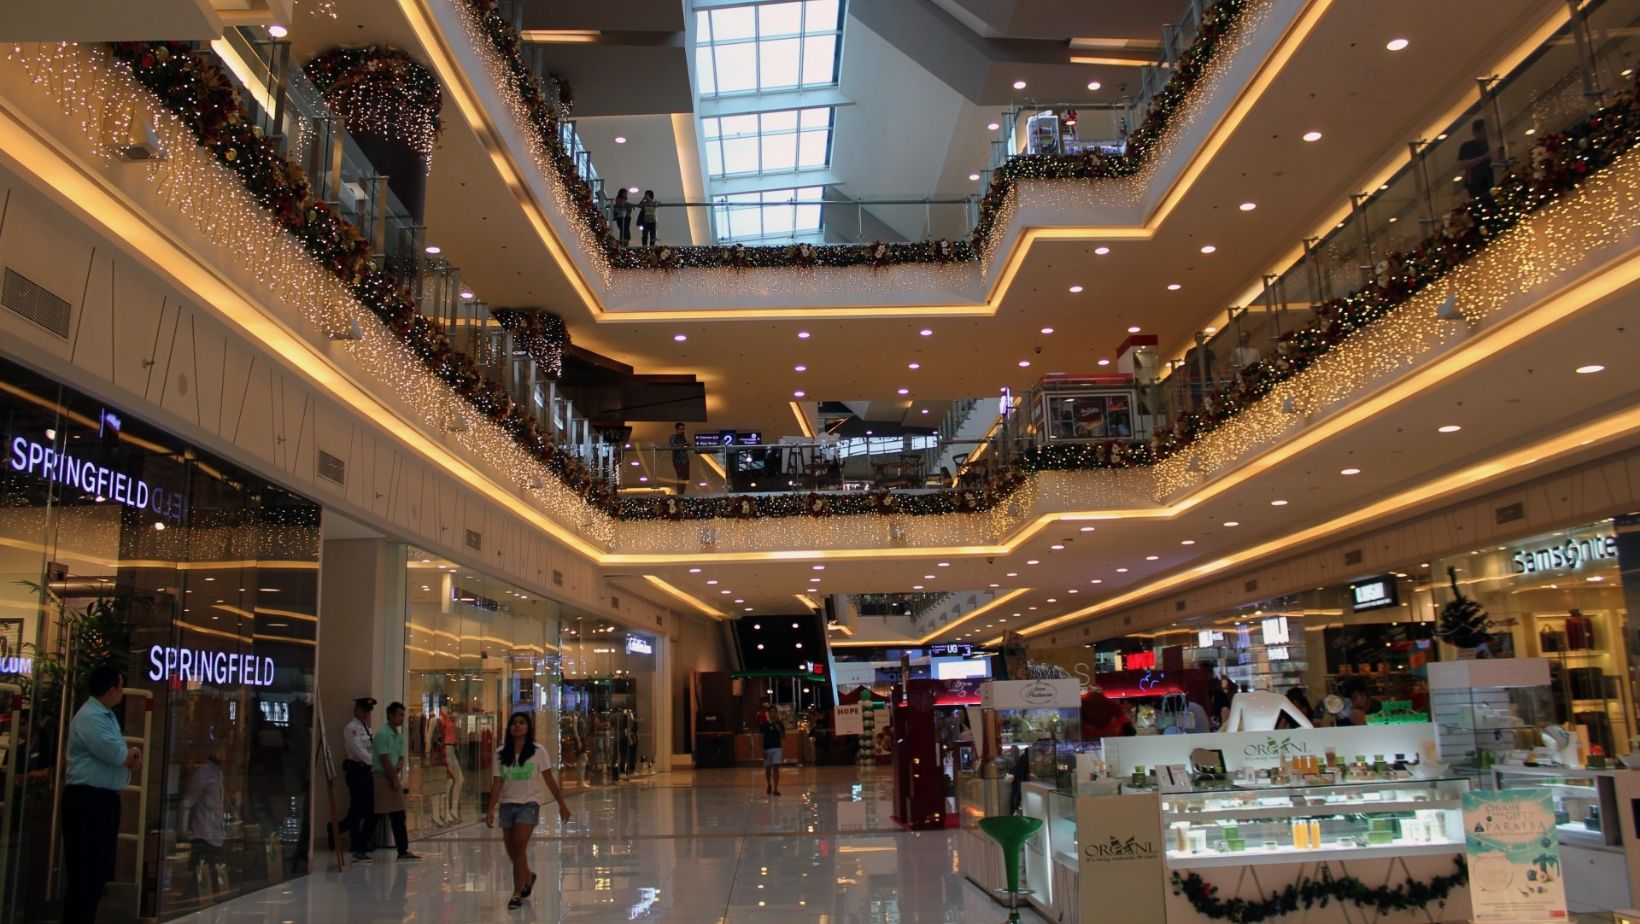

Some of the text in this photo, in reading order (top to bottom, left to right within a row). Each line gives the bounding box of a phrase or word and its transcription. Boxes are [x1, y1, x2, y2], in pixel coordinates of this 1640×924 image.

[723, 435, 733, 446] 2
[11, 436, 149, 509] SPRINGFIELD
[947, 644, 958, 653] UG
[149, 645, 274, 686] SPRINGFIELD
[837, 707, 859, 716] HOPE
